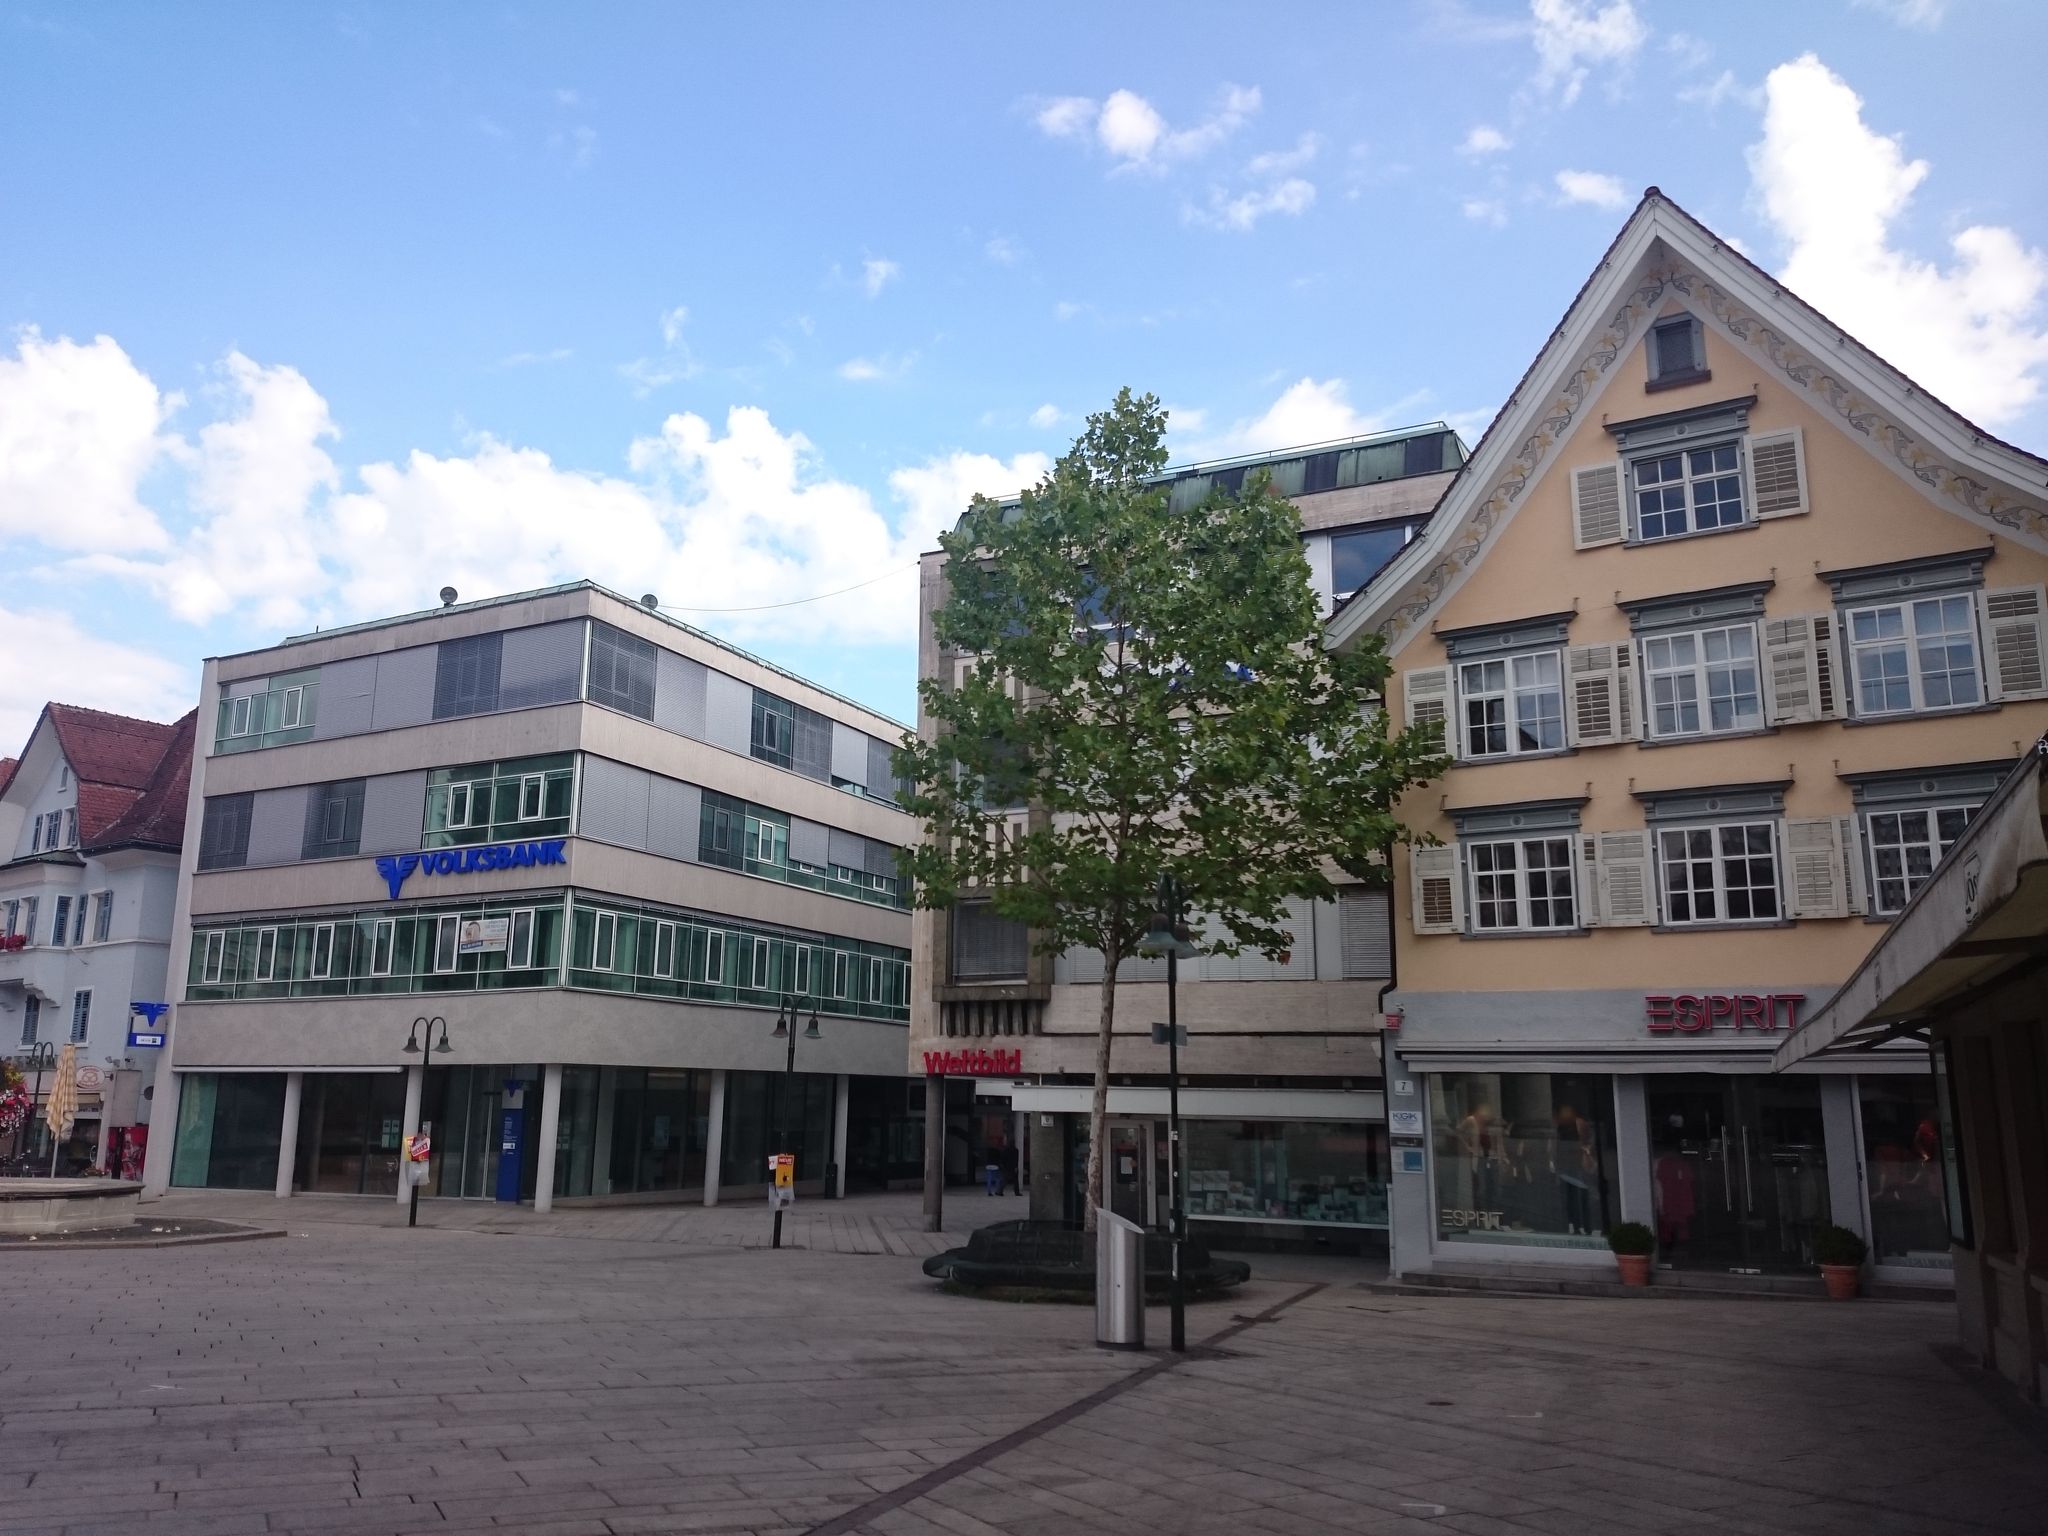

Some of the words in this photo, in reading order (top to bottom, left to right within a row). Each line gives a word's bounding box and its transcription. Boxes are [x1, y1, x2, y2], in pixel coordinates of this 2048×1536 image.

[420, 840, 566, 875] VOLKSBANK
[1645, 994, 1805, 1030] ESPRIT
[924, 1049, 1021, 1074] Weltbild
[1441, 1209, 1504, 1227] ESPRIT
